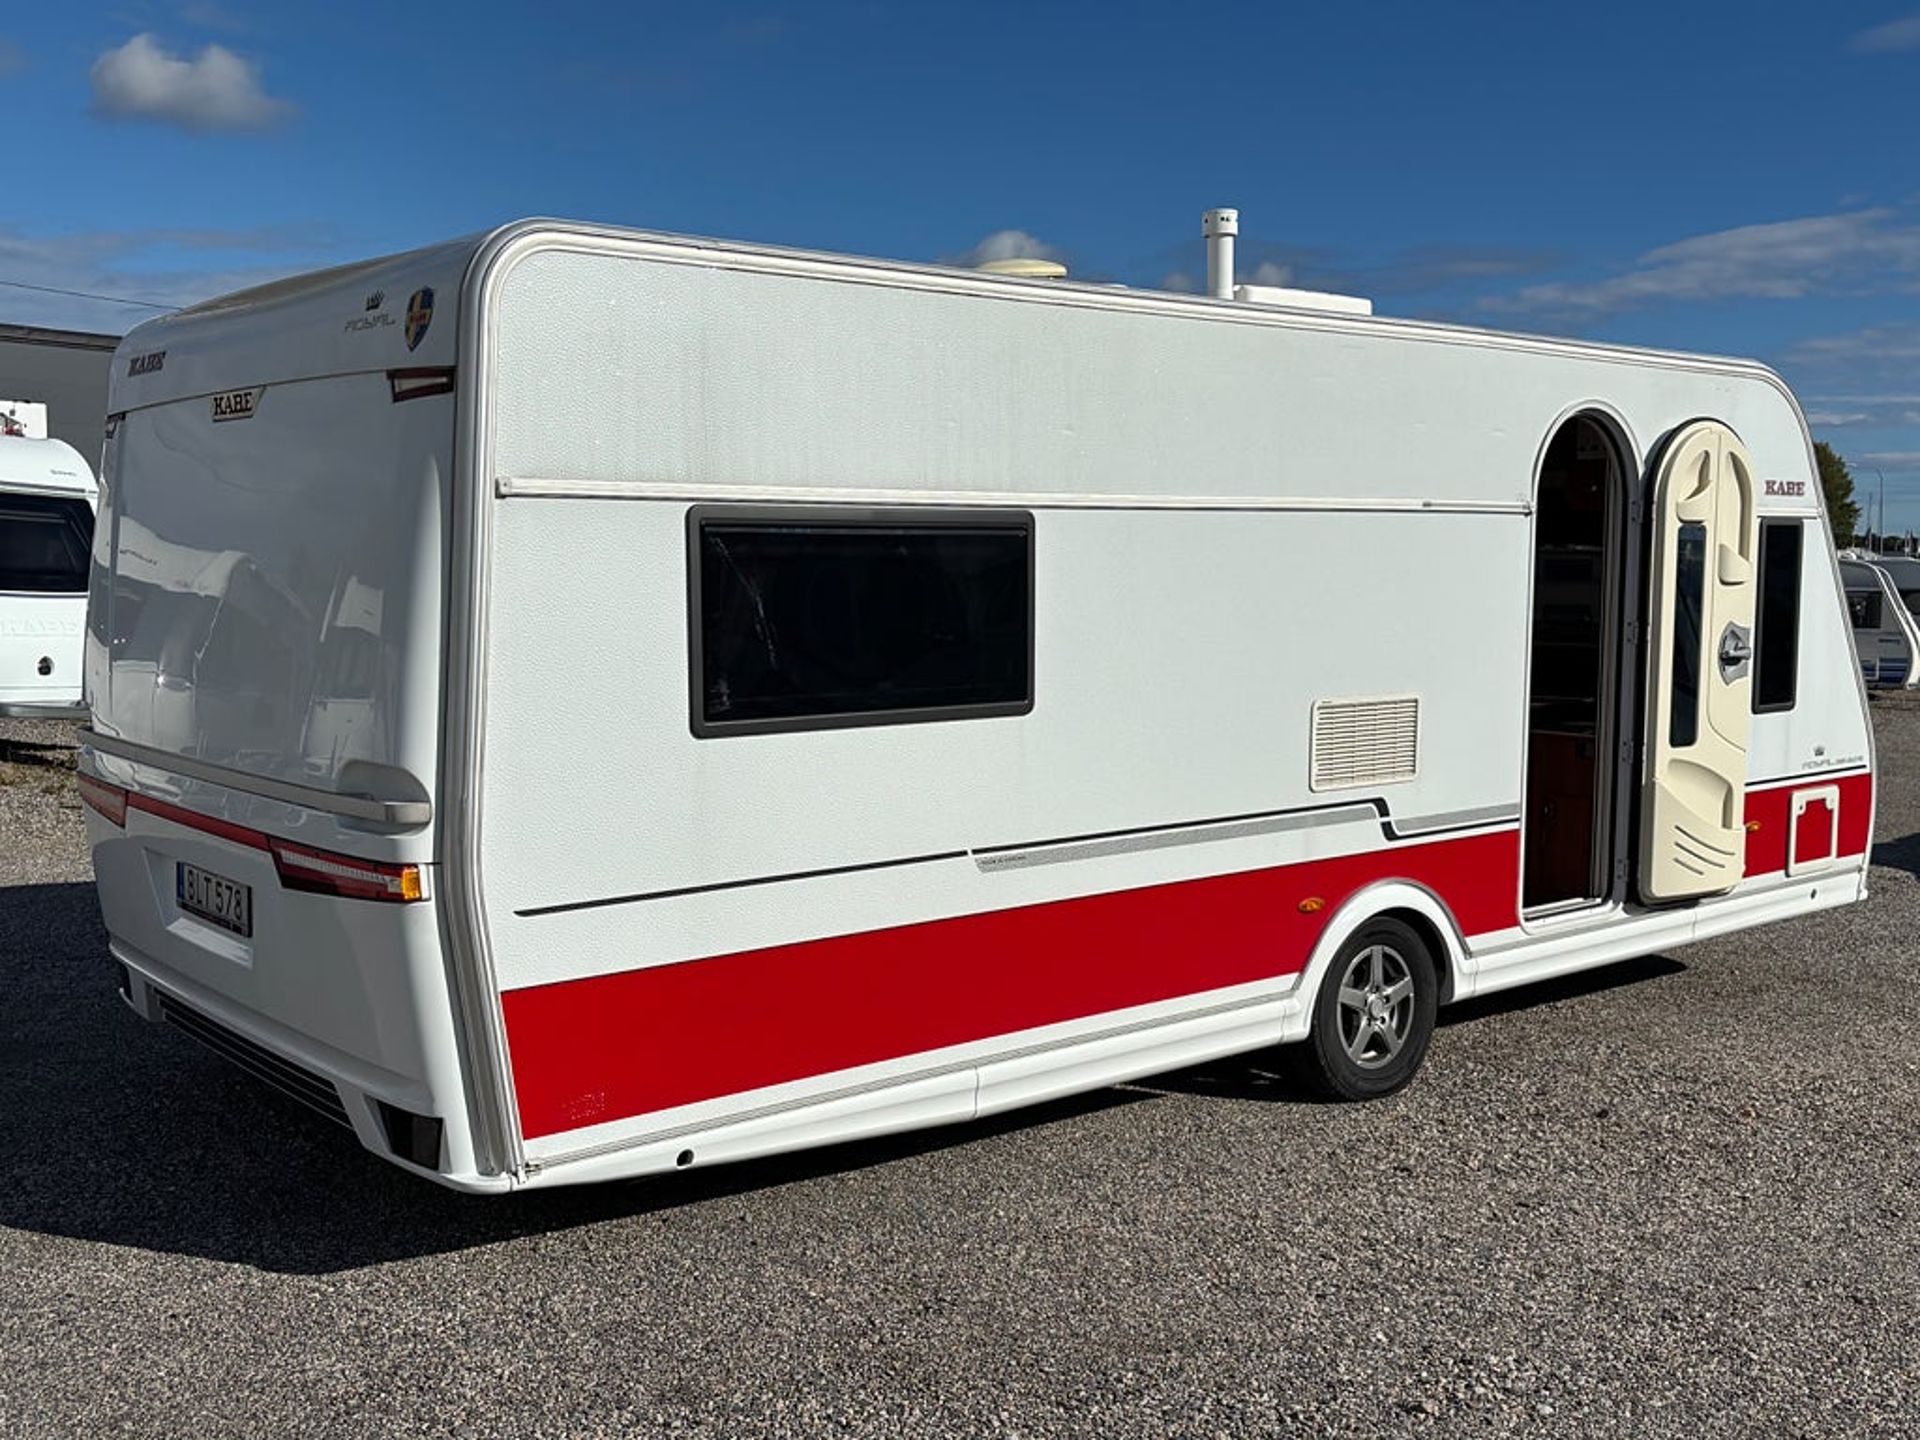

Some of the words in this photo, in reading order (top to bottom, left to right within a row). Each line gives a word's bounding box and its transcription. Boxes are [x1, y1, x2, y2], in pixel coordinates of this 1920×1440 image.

[128, 350, 167, 378] KABE
[213, 391, 253, 416] KABE
[1764, 479, 1805, 497] KABE
[215, 880, 243, 921] 578
